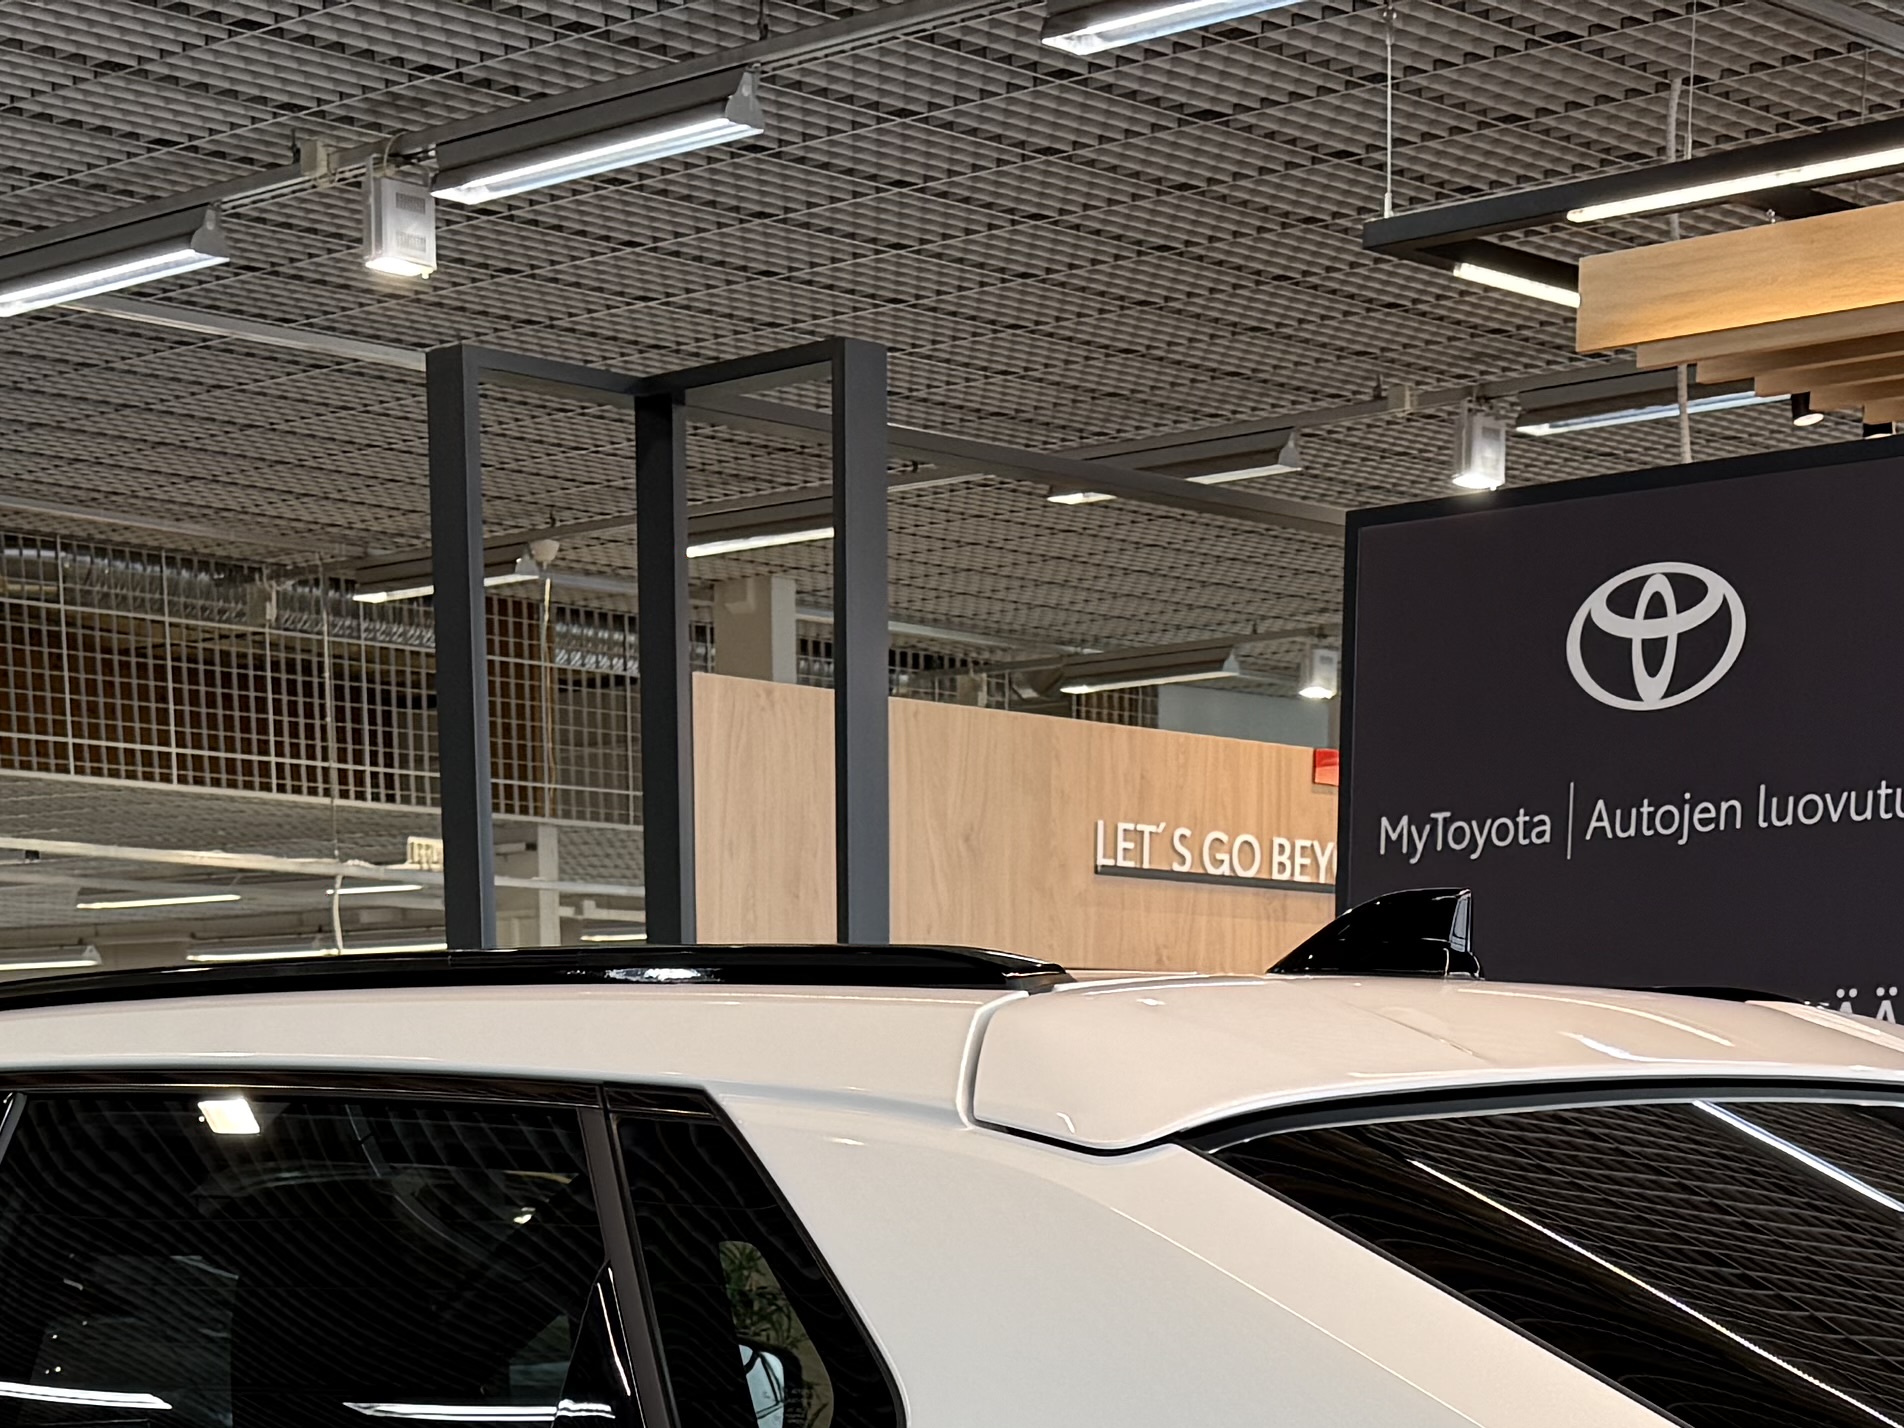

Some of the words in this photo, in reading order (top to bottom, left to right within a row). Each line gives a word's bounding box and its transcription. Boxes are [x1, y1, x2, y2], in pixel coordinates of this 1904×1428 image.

[1202, 830, 1261, 878] GO
[1271, 836, 1337, 884] BEY
[1379, 809, 1551, 865] MyToyota
[1586, 792, 1742, 846] Autojen
